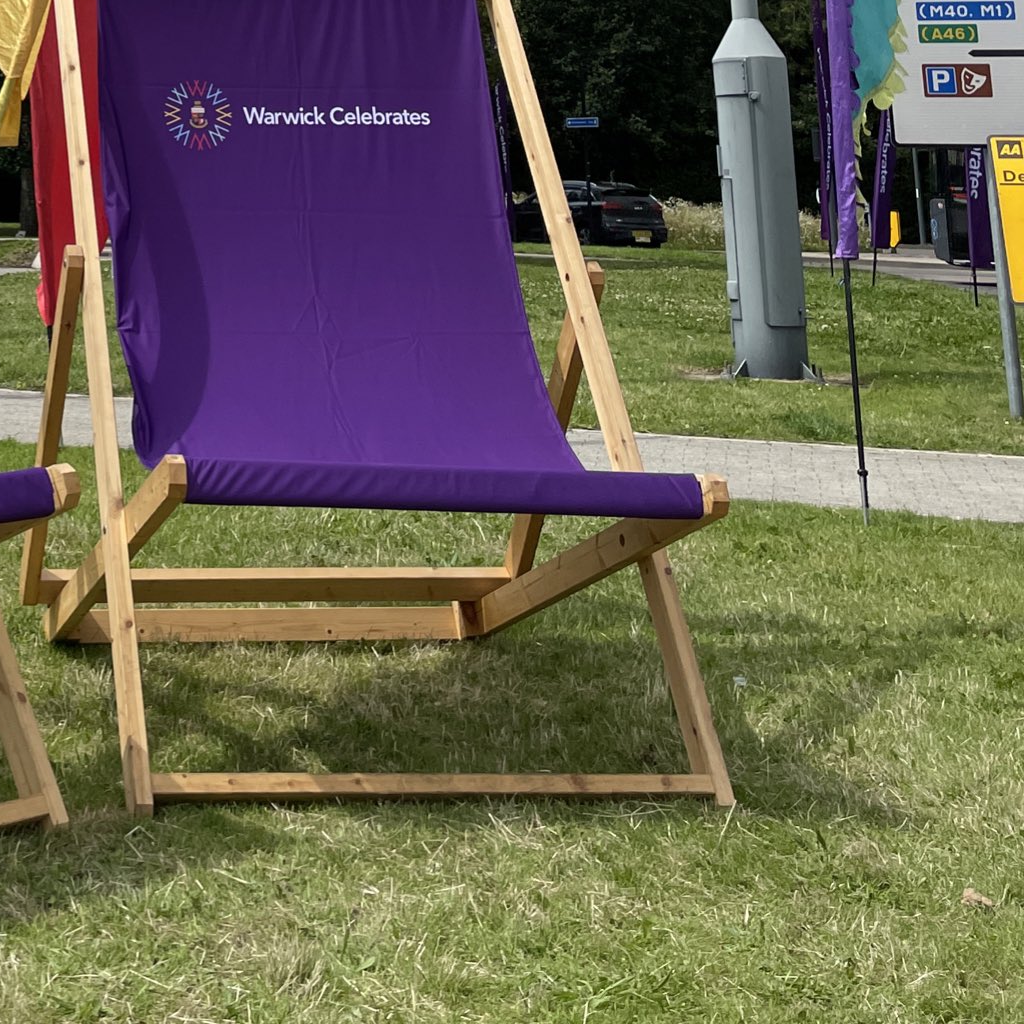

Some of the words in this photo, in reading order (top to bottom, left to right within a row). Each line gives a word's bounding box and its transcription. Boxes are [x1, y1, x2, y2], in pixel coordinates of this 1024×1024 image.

[980, 3, 1012, 18] M1)
[921, 27, 975, 41] (A46)
[932, 70, 950, 91] P
[242, 106, 326, 125] Warwick
[329, 106, 431, 125] Celebrates
[1000, 144, 1021, 156] AA
